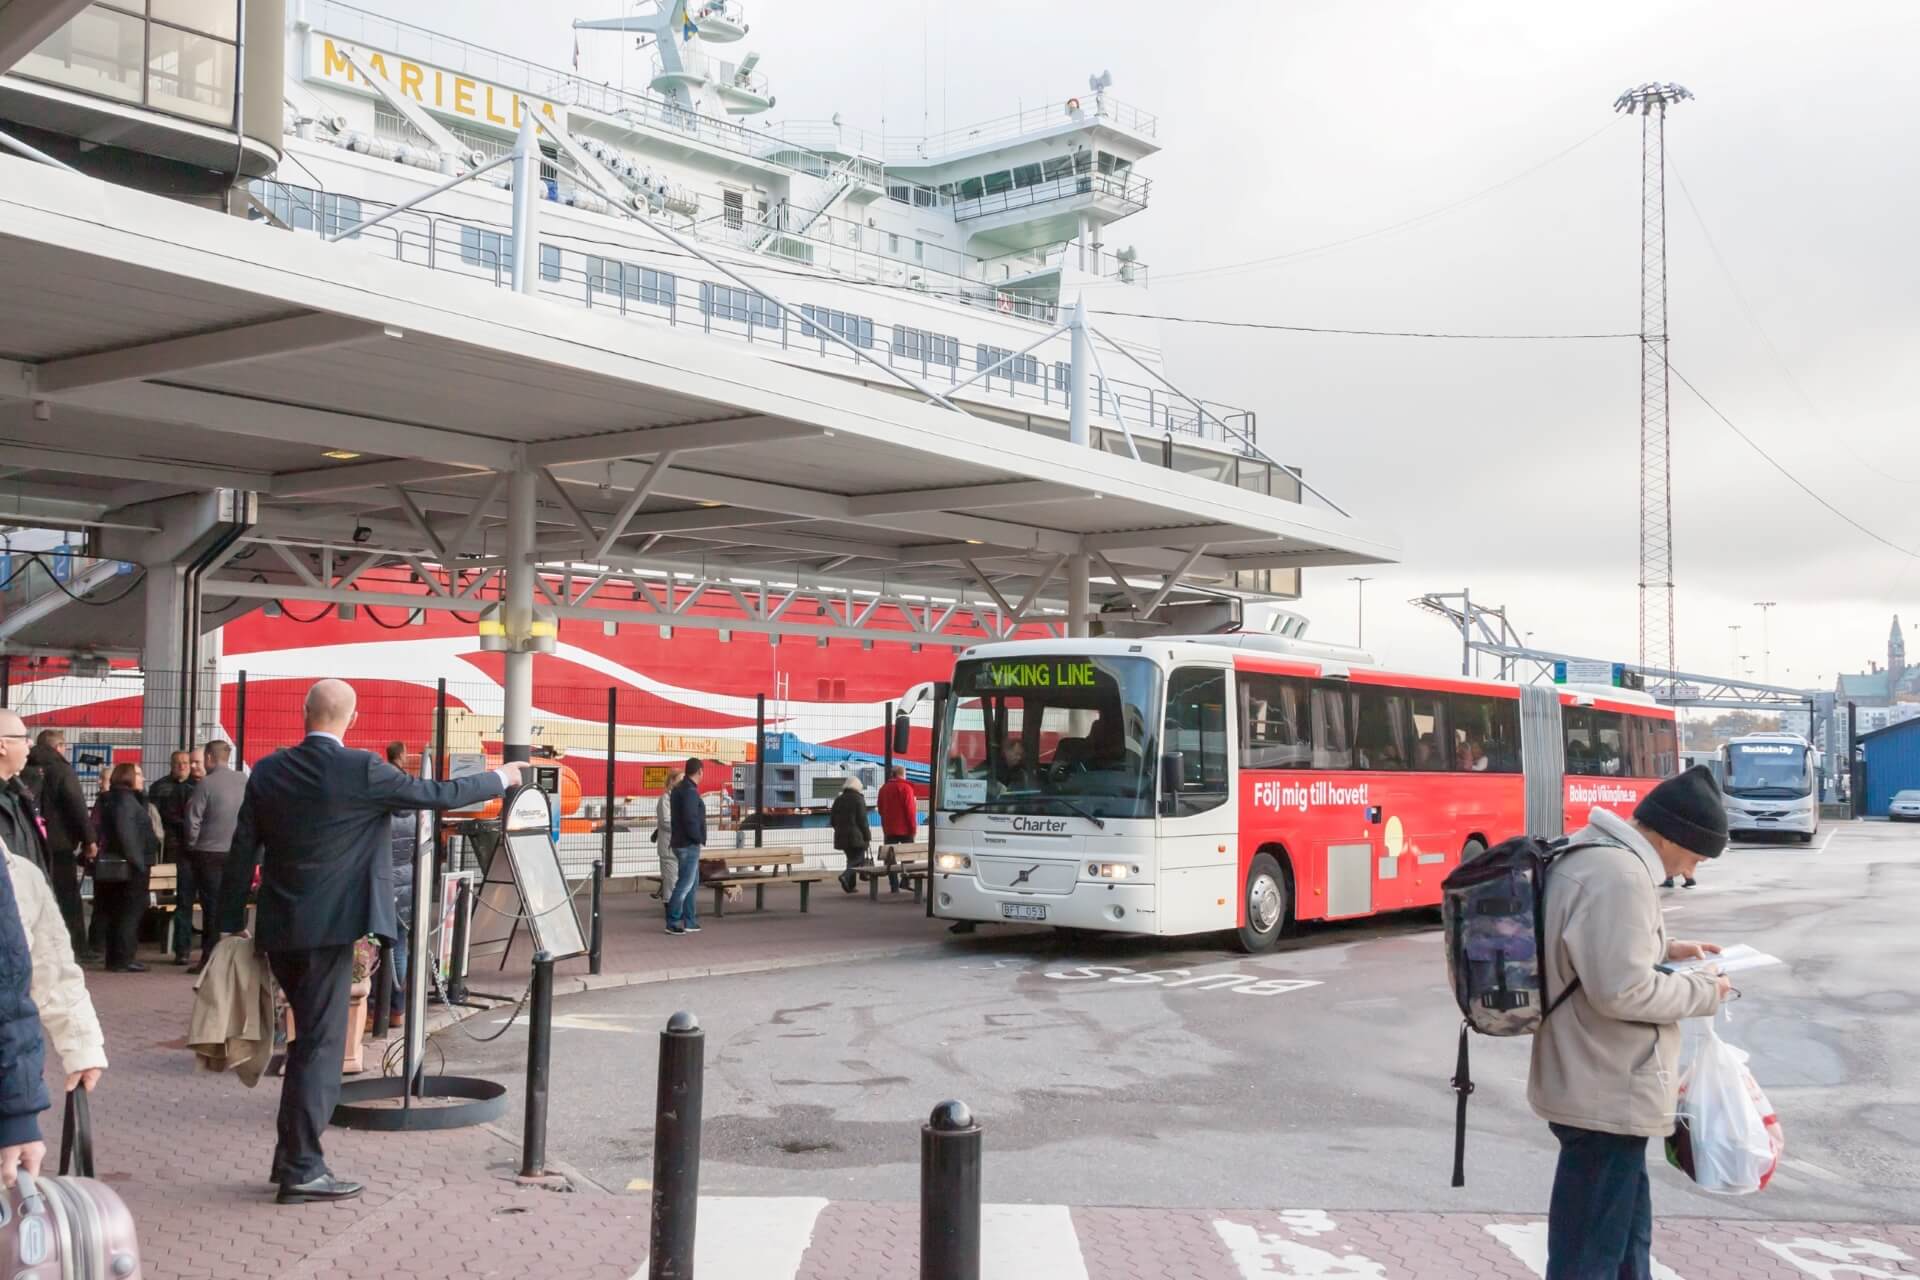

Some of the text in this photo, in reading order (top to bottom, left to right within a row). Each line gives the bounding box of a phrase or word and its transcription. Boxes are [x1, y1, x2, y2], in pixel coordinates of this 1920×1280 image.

[991, 663, 1096, 686] VIKING LINE
[1254, 781, 1368, 812] Följ mig till havet!
[1570, 784, 1587, 802] Boka
[1013, 817, 1067, 832] Charter
[1044, 966, 1325, 996] BUSS
